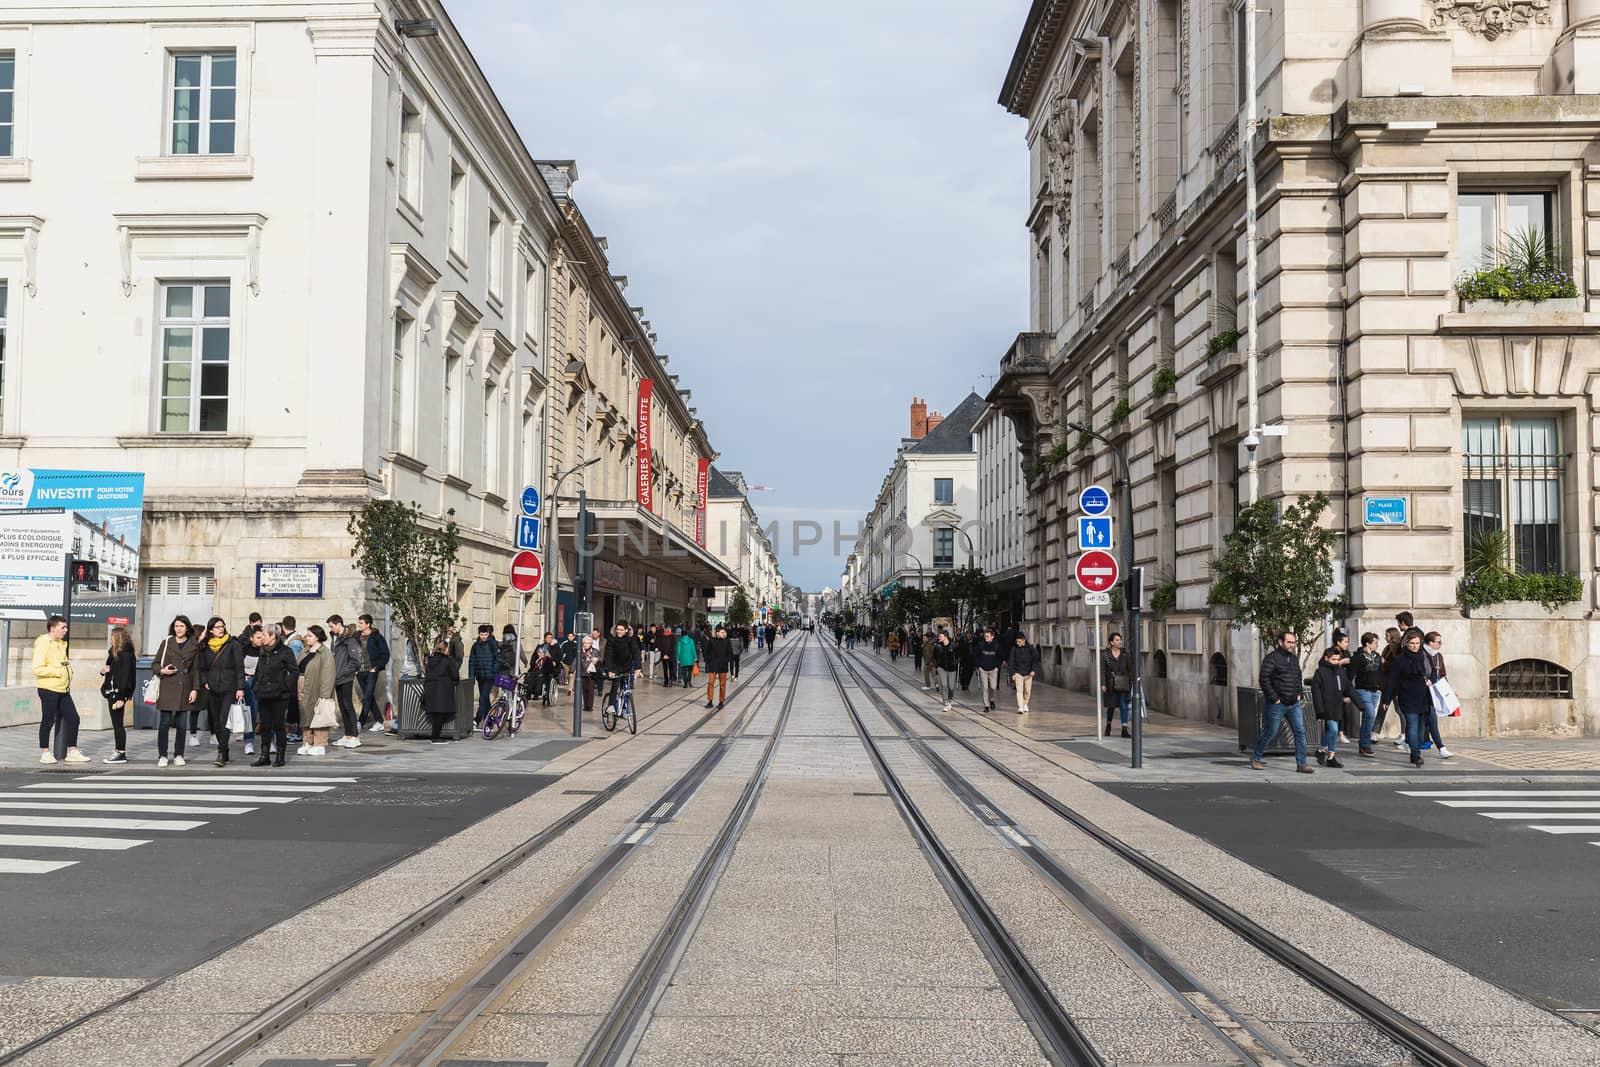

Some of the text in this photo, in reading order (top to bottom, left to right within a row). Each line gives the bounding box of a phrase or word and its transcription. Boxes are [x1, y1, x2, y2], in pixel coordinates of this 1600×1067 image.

[640, 397, 649, 505] GALERIES LAFAYETTE
[37, 487, 95, 500] INVESTIT
[698, 471, 706, 509] LAFAYETTE
[26, 554, 60, 562] EFFICACE
